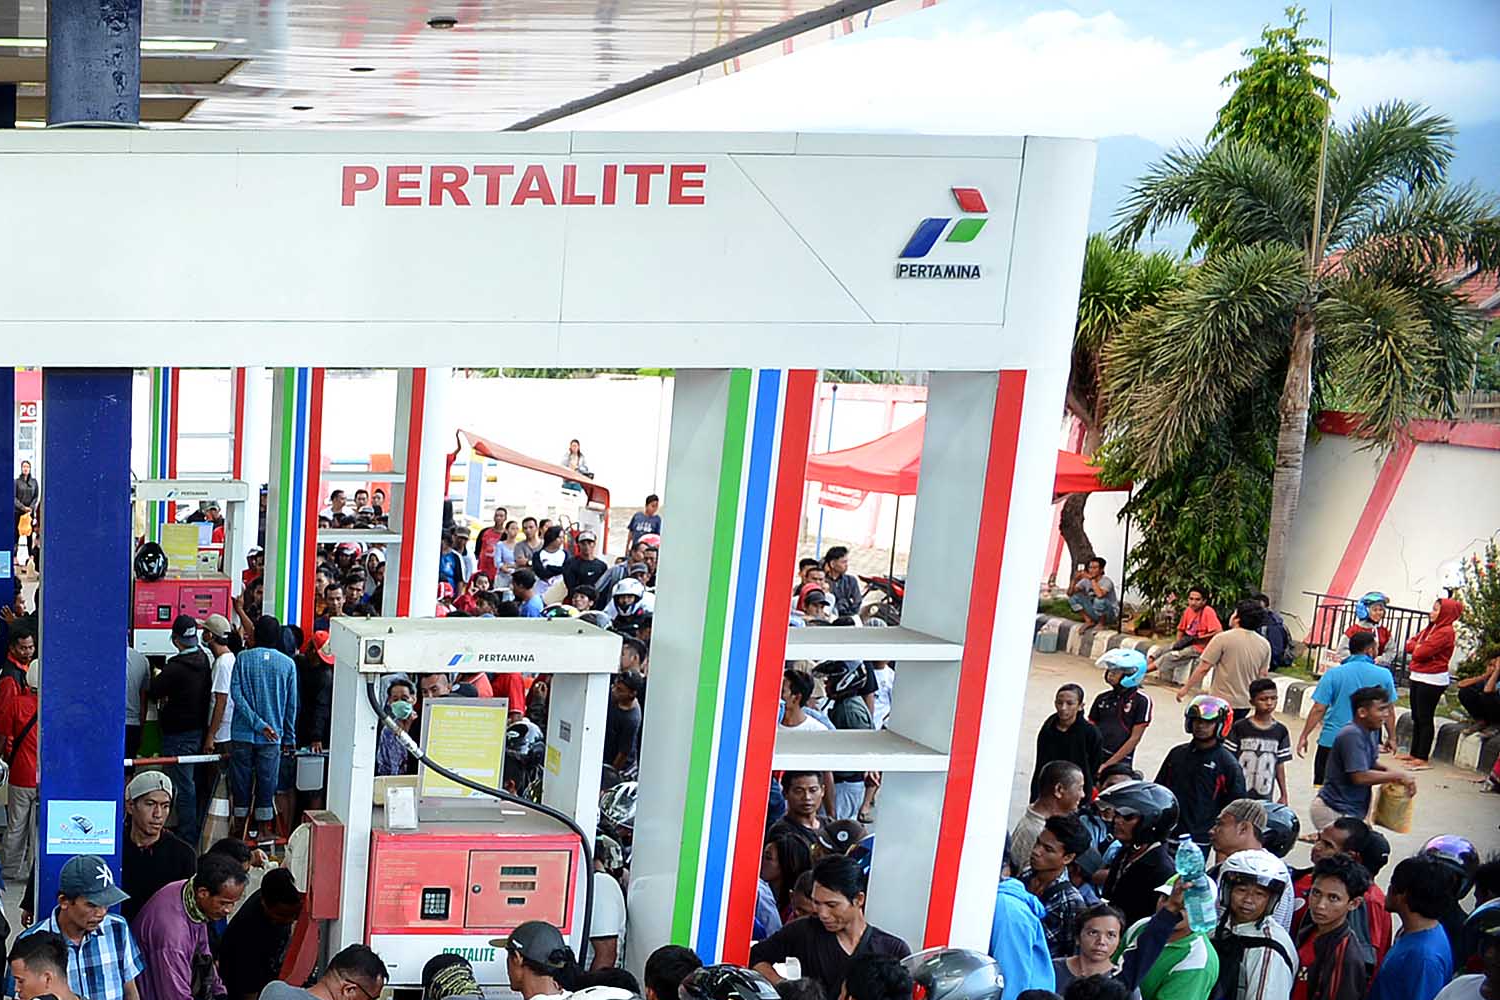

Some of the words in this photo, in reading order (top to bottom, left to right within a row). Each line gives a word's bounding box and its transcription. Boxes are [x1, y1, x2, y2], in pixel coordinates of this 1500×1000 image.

[341, 163, 707, 207] PERTALITE
[896, 263, 982, 280] PERTAMINA
[478, 653, 535, 663] PERTAMINA
